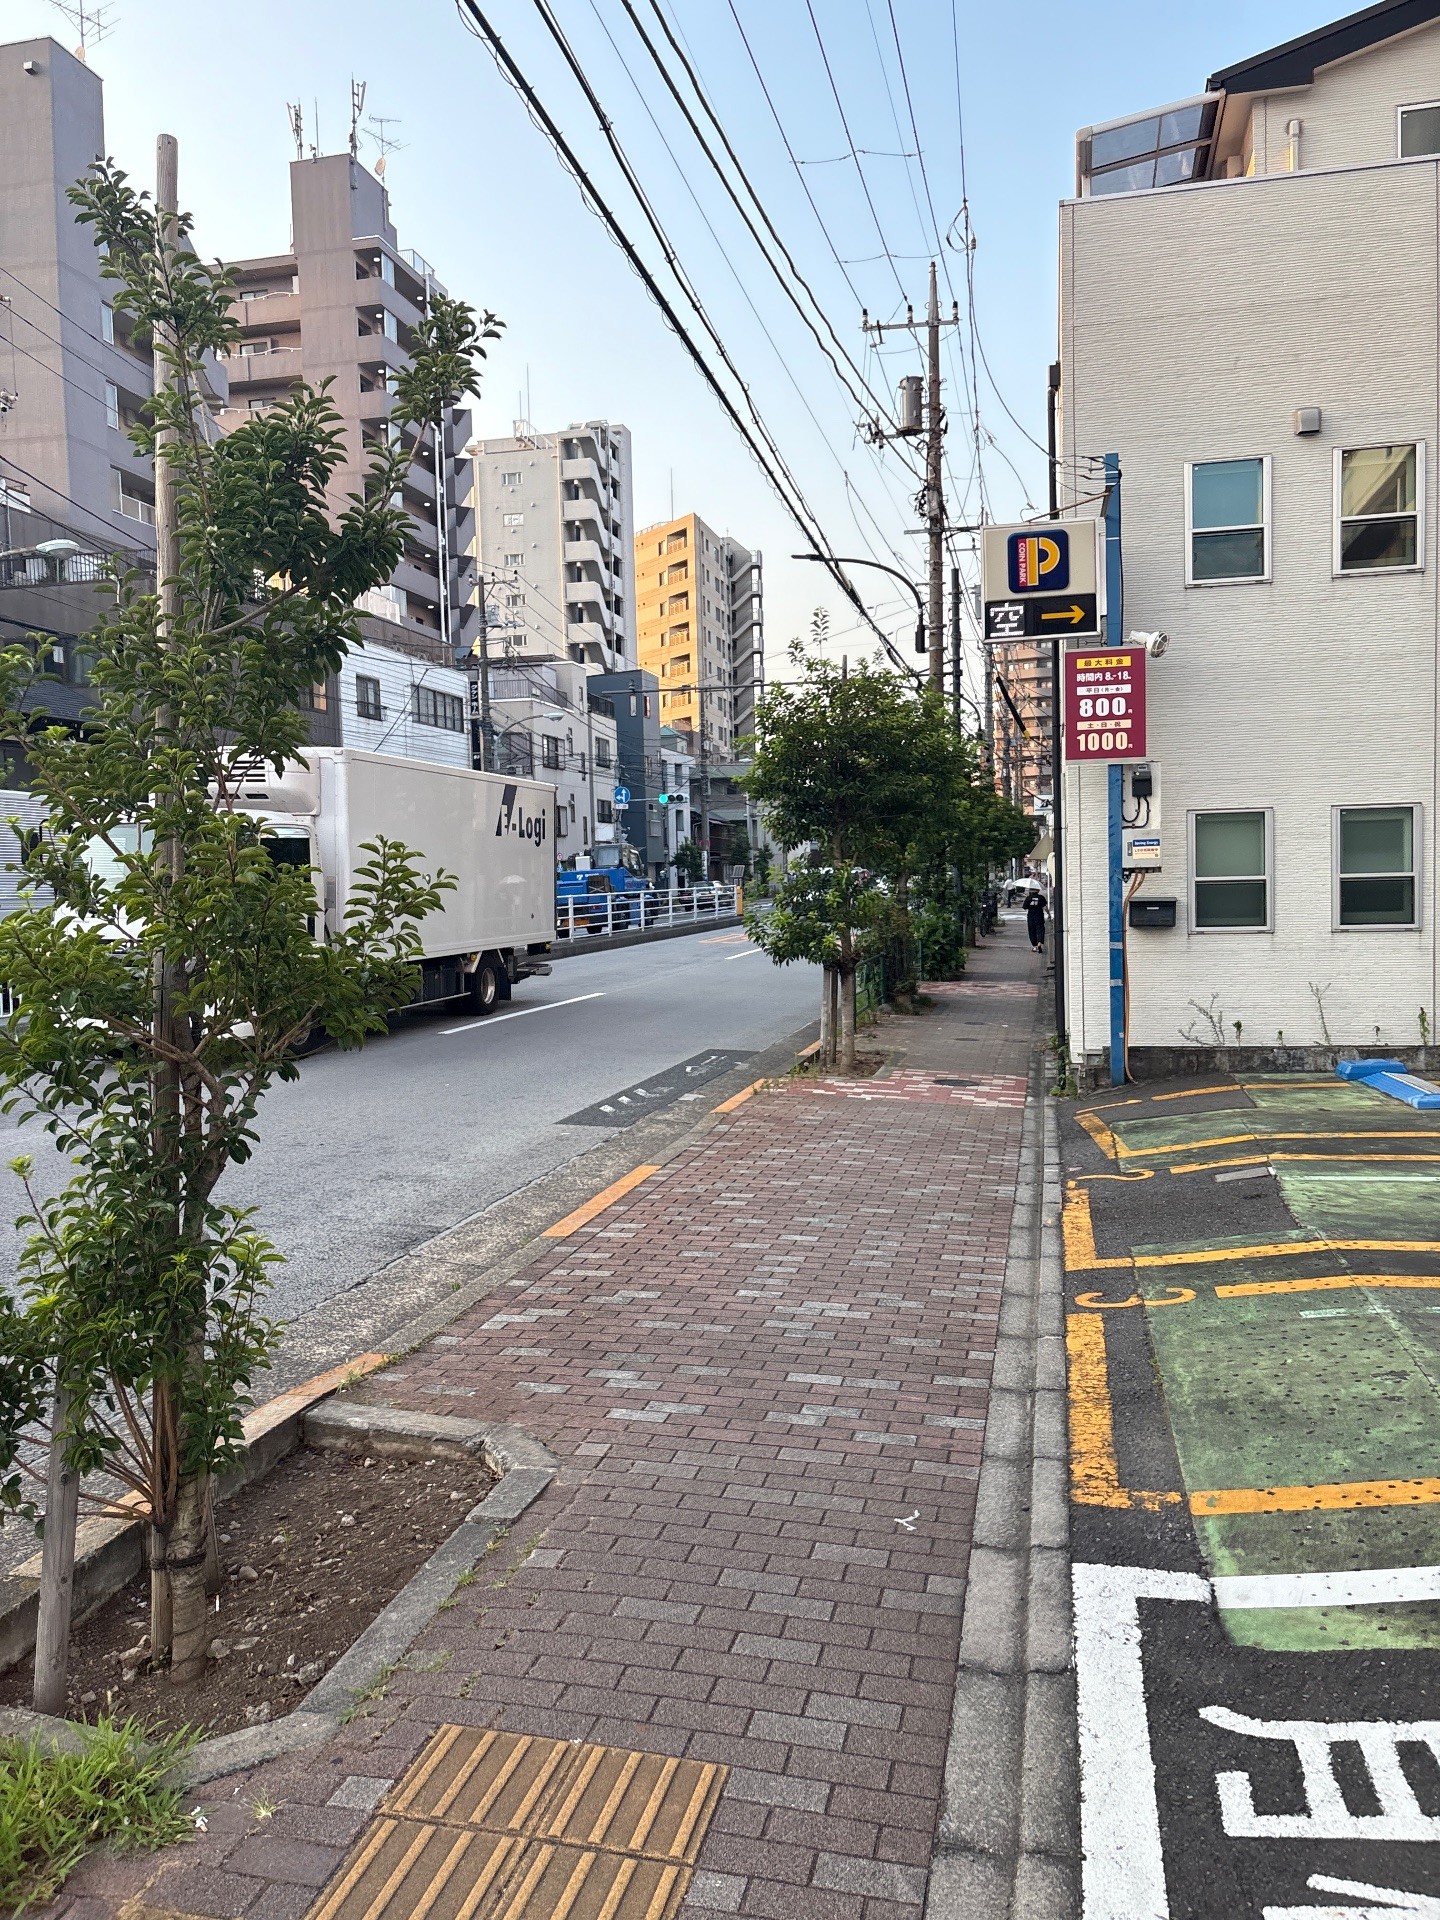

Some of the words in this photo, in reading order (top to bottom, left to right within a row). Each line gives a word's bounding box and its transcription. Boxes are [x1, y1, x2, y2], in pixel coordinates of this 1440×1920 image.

[1018, 542, 1026, 562] COIN
[1018, 562, 1027, 583] PARK
[990, 602, 1024, 637] 空
[1084, 658, 1124, 667] 最大料金
[1076, 672, 1103, 683] 時間内
